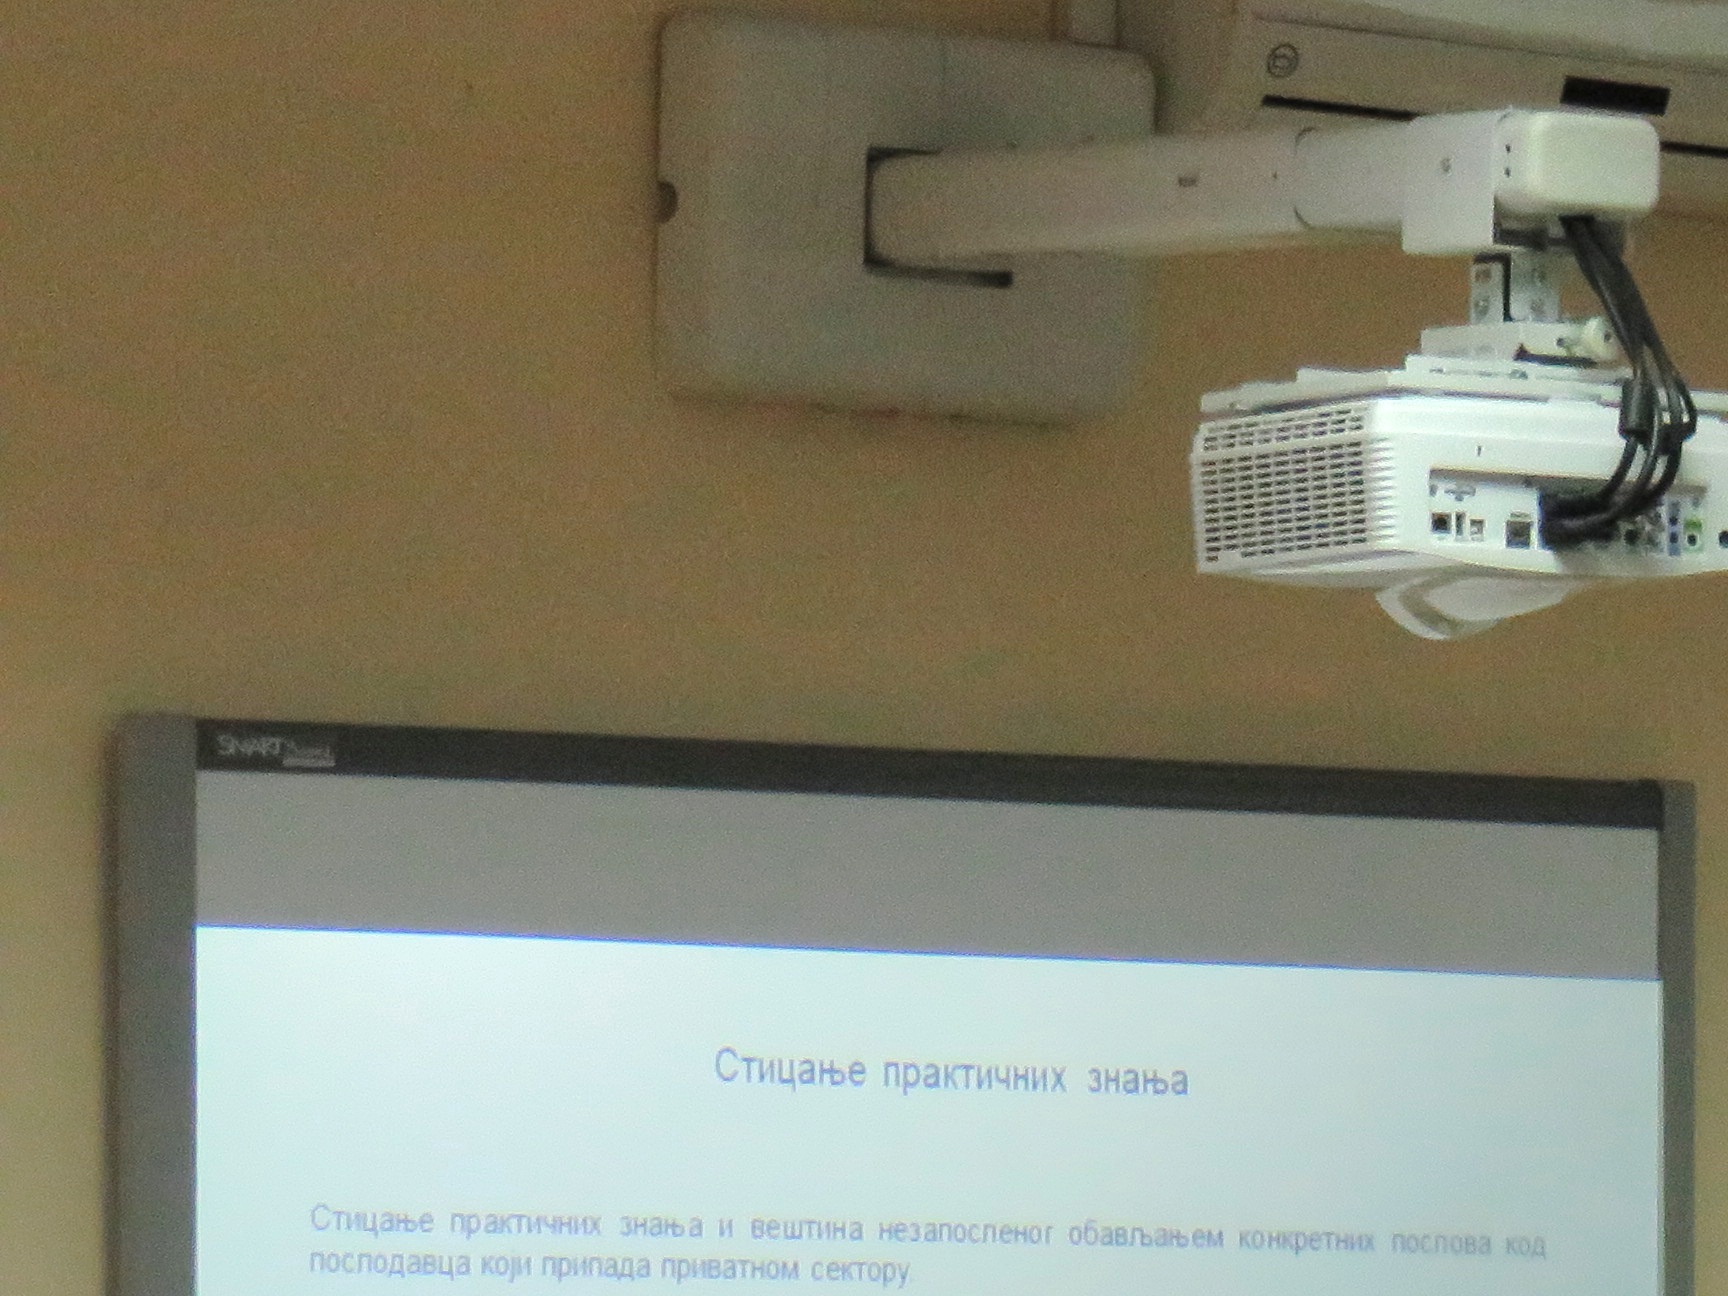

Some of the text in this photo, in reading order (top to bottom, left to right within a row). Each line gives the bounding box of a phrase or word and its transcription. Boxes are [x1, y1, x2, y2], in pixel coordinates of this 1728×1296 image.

[715, 1046, 1188, 1096] Стицање практичних знања
[310, 1203, 434, 1238] Стицање
[450, 1212, 601, 1239] практичних
[621, 1216, 703, 1237] знања
[719, 1218, 733, 1237] и
[751, 1217, 863, 1241] вештина
[1068, 1219, 1224, 1248] обављањем
[1239, 1229, 1375, 1256] конкретних
[1505, 1236, 1547, 1260] код
[481, 1256, 531, 1283] који
[542, 1256, 651, 1283] припада
[661, 1258, 799, 1284] приватном
